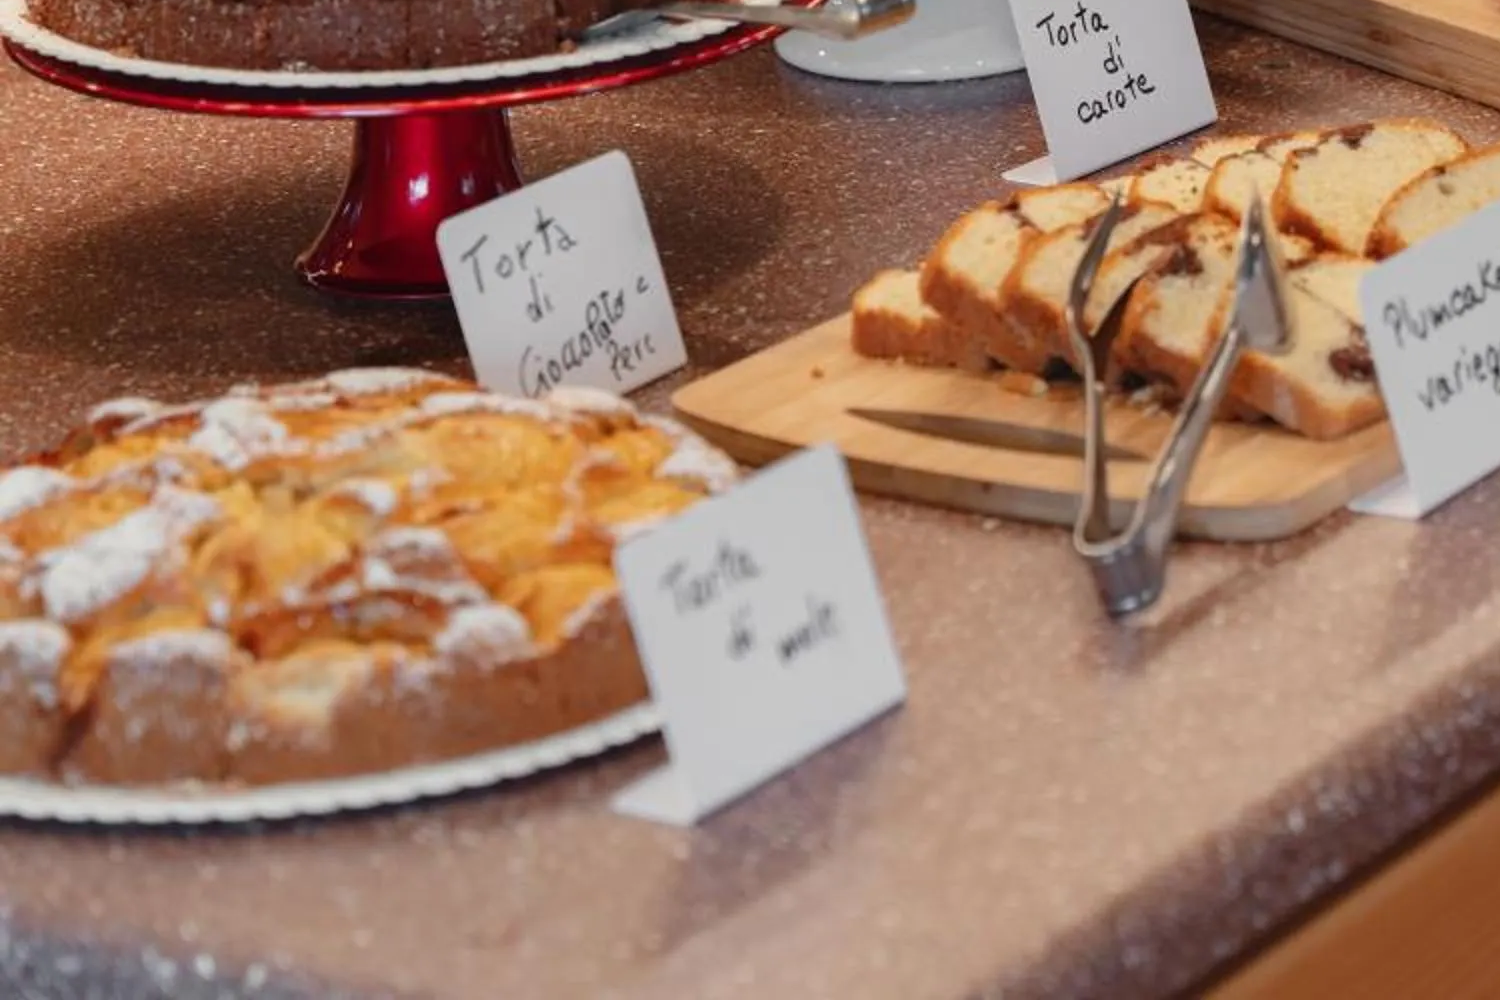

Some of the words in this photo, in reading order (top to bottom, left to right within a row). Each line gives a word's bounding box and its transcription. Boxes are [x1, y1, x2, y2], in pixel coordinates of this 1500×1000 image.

[1036, 1, 1109, 47] Torta
[1103, 35, 1125, 74] di
[1077, 73, 1156, 123] carote
[460, 205, 577, 293] Torta
[526, 271, 554, 322] di
